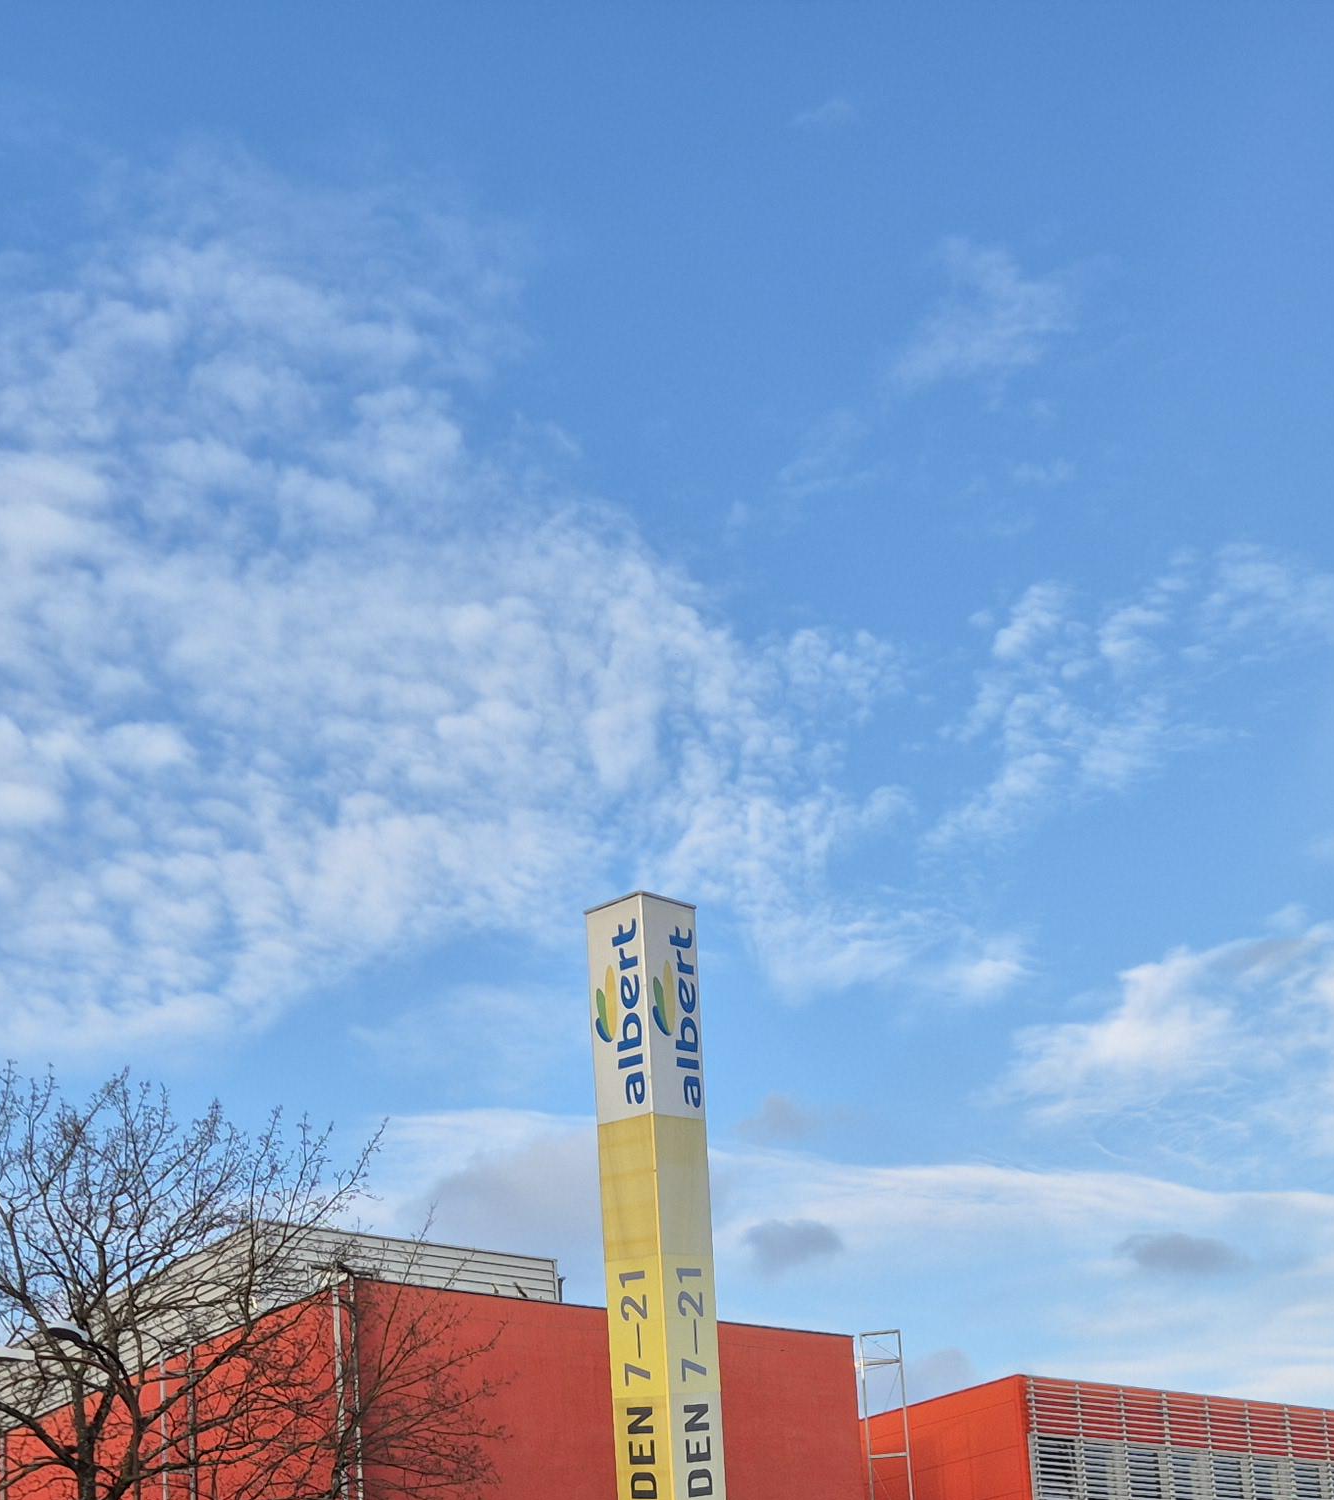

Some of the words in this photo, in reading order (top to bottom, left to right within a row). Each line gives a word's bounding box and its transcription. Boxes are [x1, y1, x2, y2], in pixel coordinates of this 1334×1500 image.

[612, 918, 646, 1105] albert
[669, 925, 701, 1109] albert
[626, 1406, 658, 1500] DEN
[683, 1404, 713, 1498] DEN
